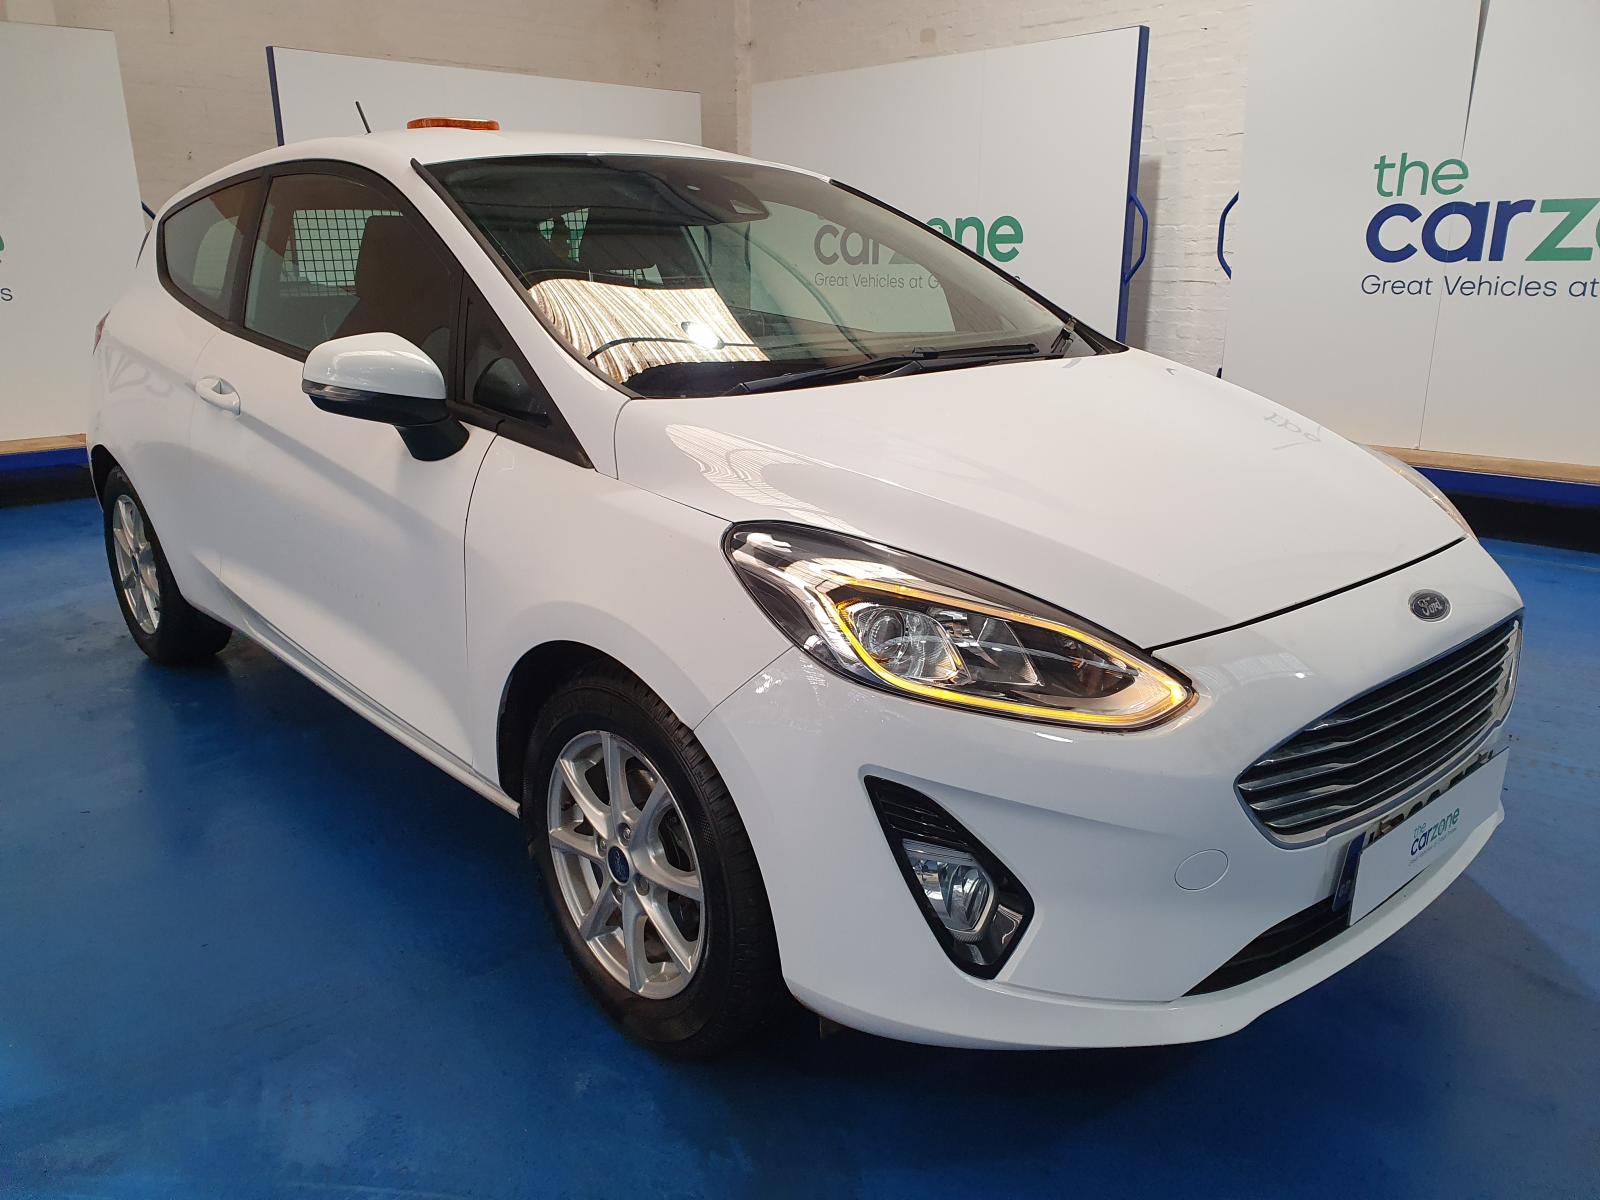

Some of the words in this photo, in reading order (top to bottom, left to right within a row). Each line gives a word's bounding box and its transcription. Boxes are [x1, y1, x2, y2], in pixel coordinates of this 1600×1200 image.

[1374, 152, 1469, 197] the
[1366, 198, 1600, 263] carz
[814, 272, 848, 288] Great
[852, 273, 905, 289] Vehicles
[908, 275, 923, 289] at
[1361, 274, 1433, 295] Great
[1444, 274, 1558, 297] Vehicles
[1568, 277, 1600, 297] at
[1410, 807, 1460, 856] carzone
